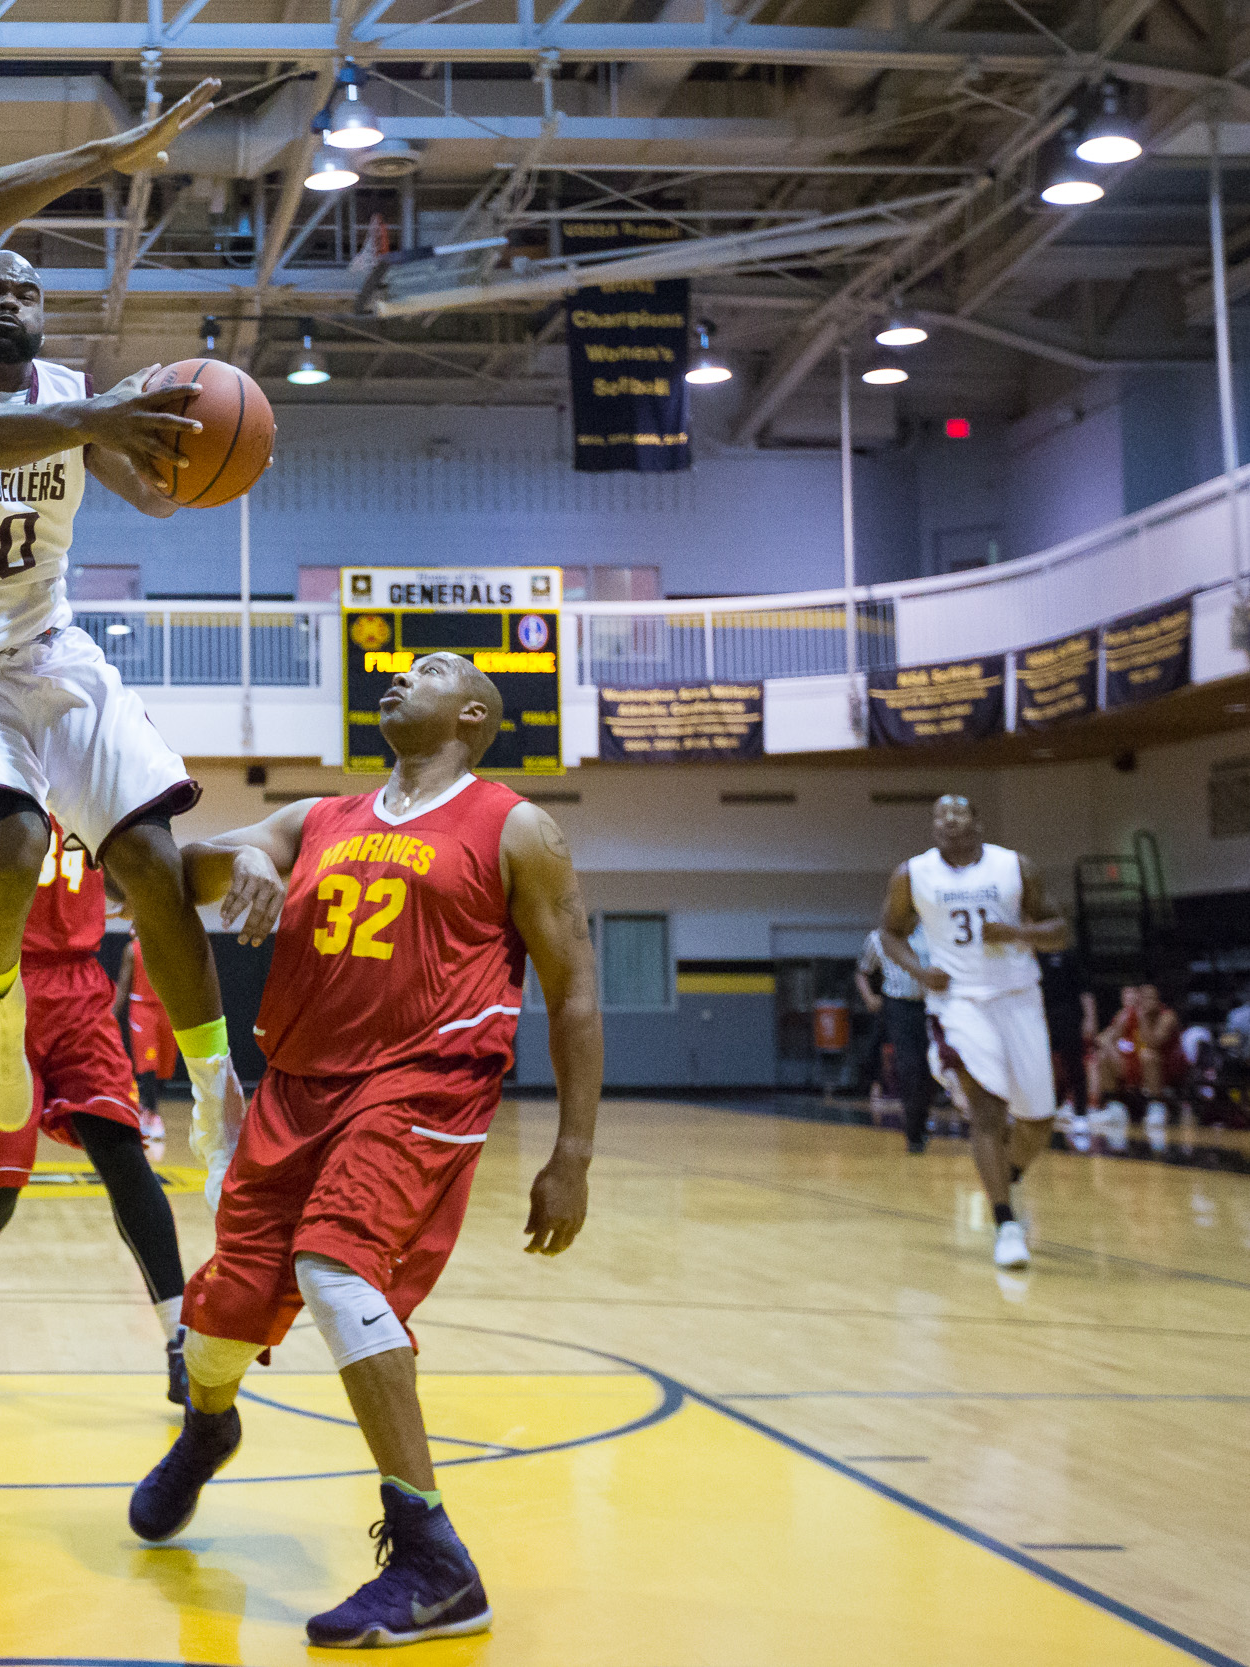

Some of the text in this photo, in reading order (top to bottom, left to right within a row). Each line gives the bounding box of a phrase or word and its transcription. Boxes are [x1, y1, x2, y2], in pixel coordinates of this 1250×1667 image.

[389, 583, 513, 605] GENERALS
[315, 832, 436, 876] MARINES
[313, 873, 408, 960] 32
